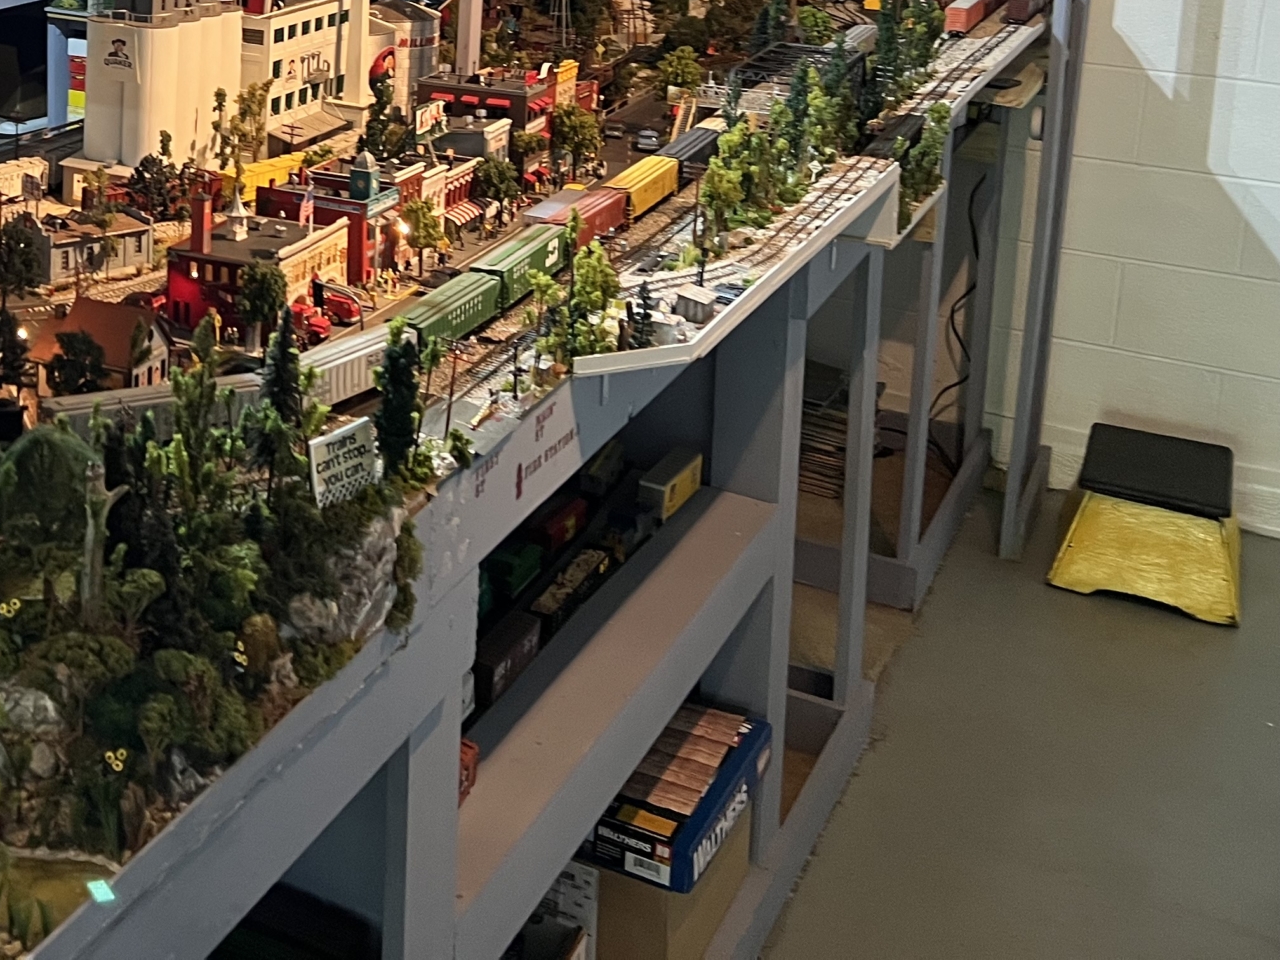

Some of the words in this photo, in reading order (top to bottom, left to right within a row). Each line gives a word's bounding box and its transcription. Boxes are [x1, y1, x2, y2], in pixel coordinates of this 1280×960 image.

[103, 58, 133, 69] QUAKER
[326, 432, 357, 455] Trains
[316, 454, 341, 475] can't
[322, 470, 344, 490] you
[597, 825, 652, 853] WALTHERS
[692, 783, 749, 882] WALTHERS
